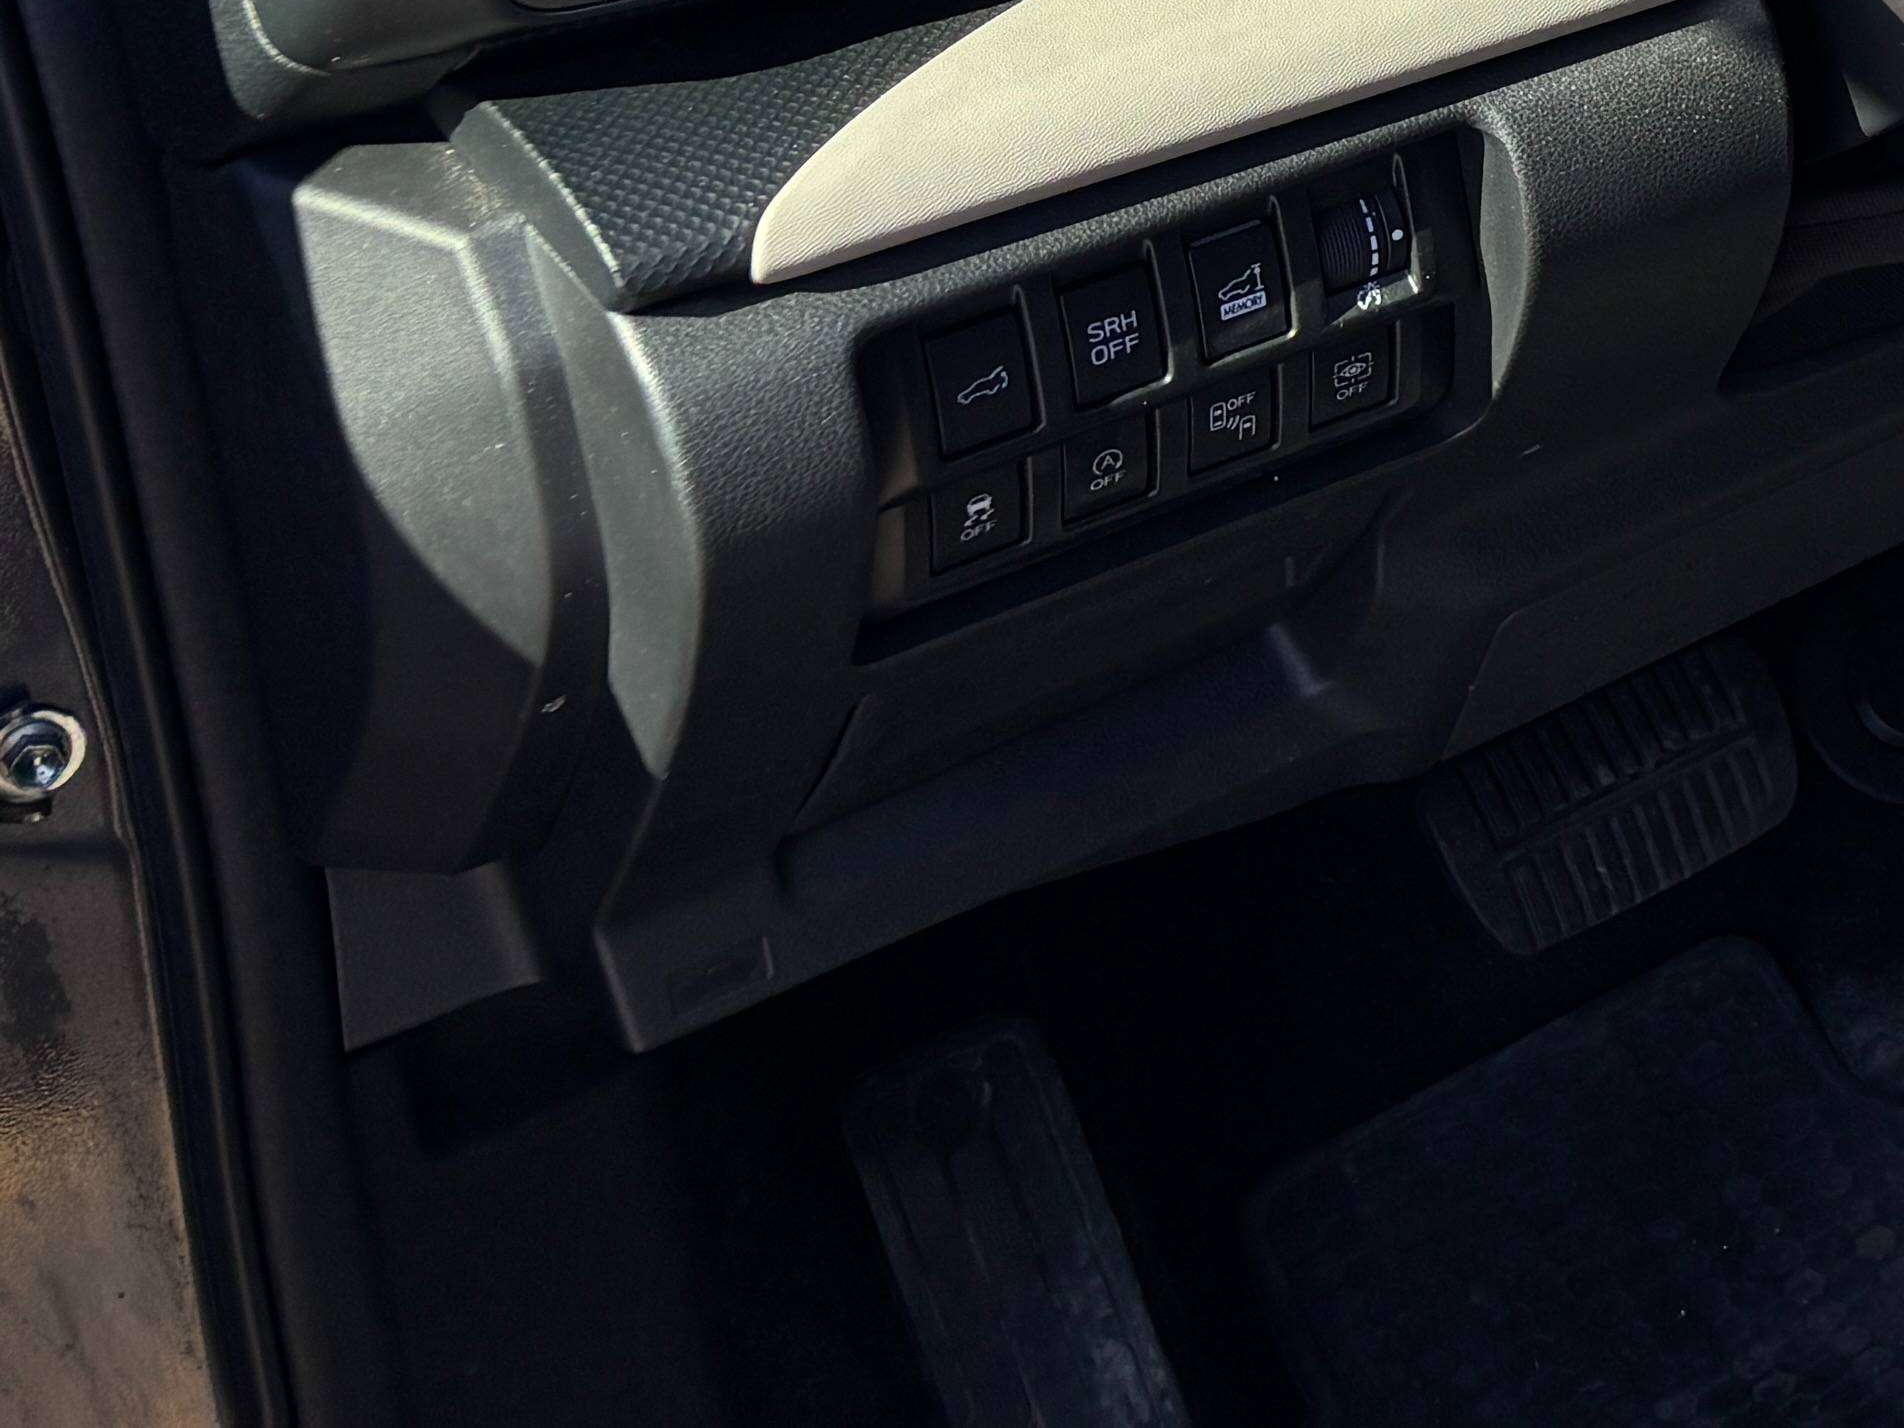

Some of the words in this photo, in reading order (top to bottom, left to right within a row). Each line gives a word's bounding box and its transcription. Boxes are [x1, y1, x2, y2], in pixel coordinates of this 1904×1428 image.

[1223, 295, 1264, 317] MEMORY
[1087, 310, 1138, 343] SRH
[1091, 333, 1139, 366] OFF
[1227, 392, 1256, 410] OFF
[1336, 381, 1368, 400] OFF
[1090, 470, 1126, 490] OFF
[960, 520, 998, 542] OFF
